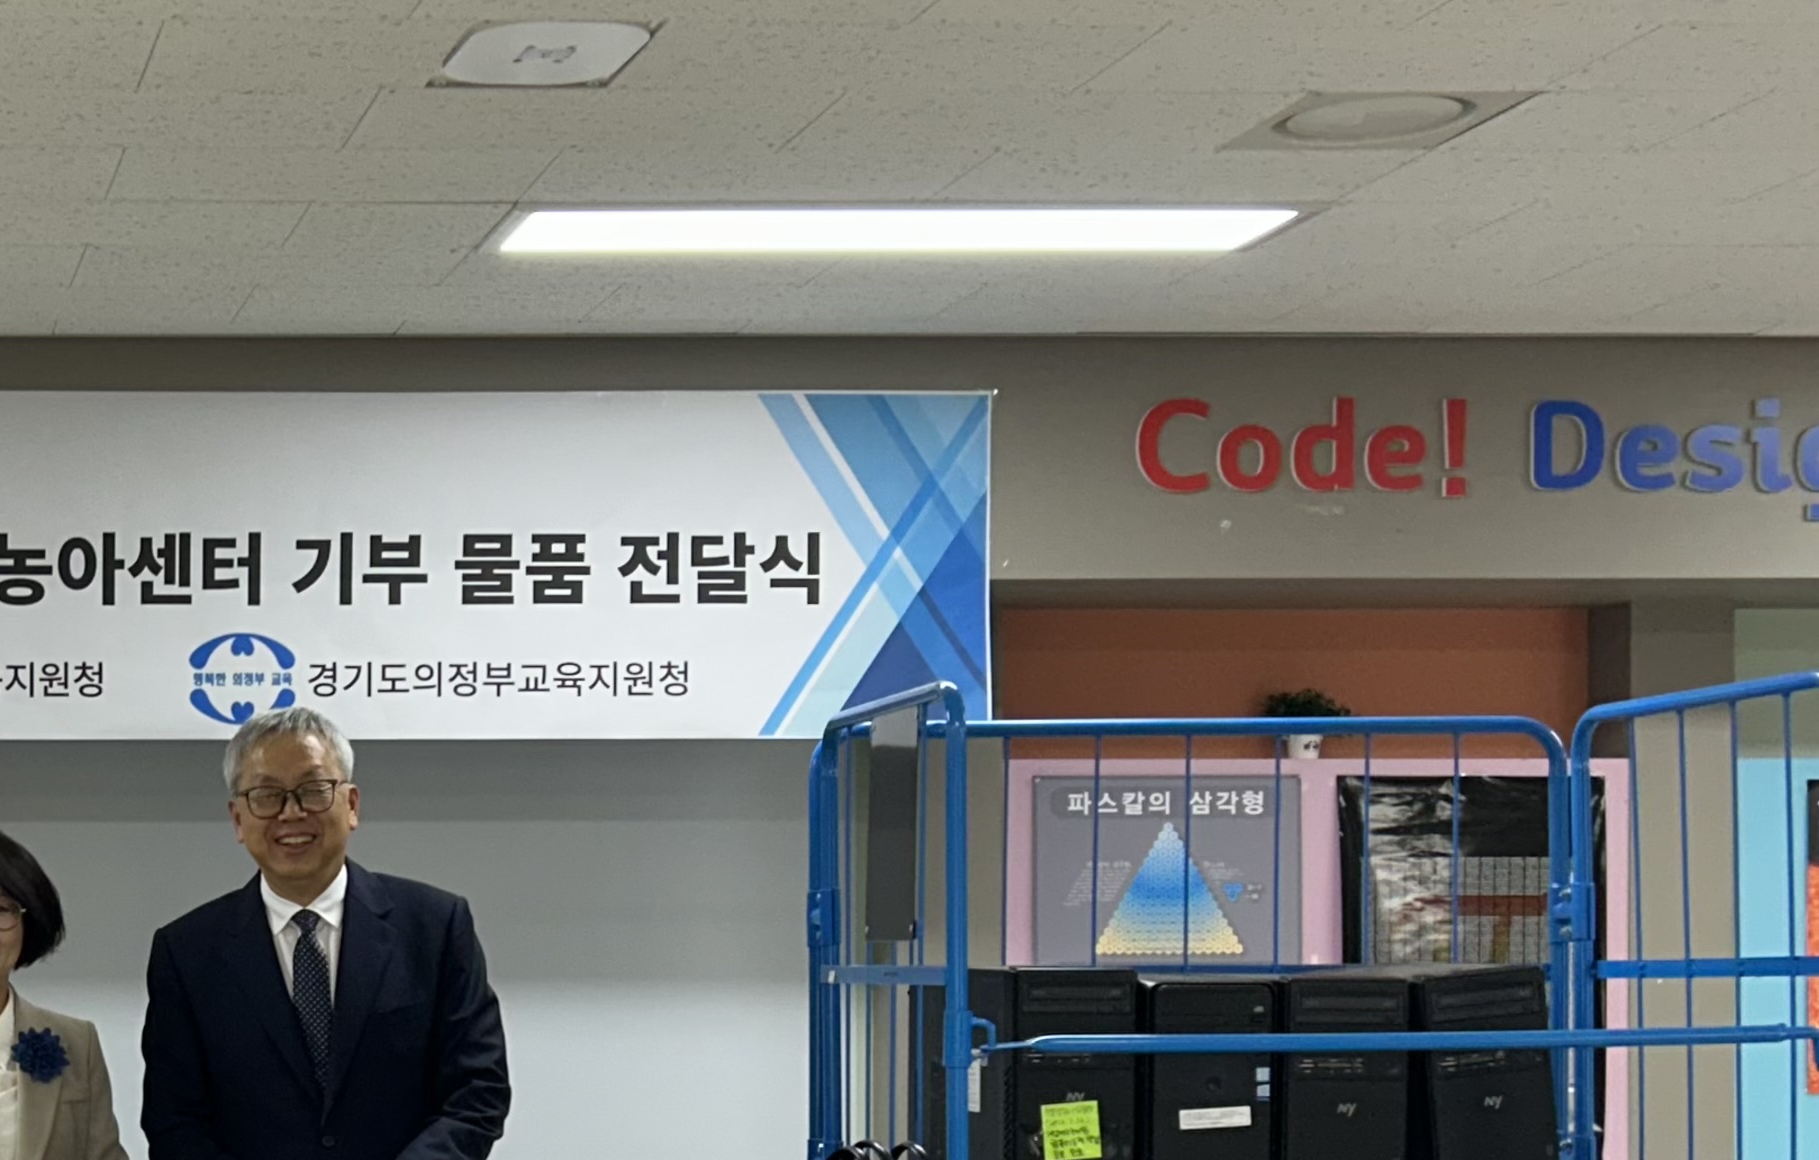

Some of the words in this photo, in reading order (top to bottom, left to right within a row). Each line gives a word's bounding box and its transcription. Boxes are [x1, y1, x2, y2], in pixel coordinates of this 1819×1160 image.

[1136, 397, 1468, 497] Code!
[292, 531, 428, 606] 기부
[454, 533, 591, 605] 물품
[617, 531, 822, 606] 전달식
[307, 661, 690, 699] 경기도의정부교육지원청
[1067, 790, 1171, 815] 파스칼의
[1189, 790, 1264, 815] 삼각형
